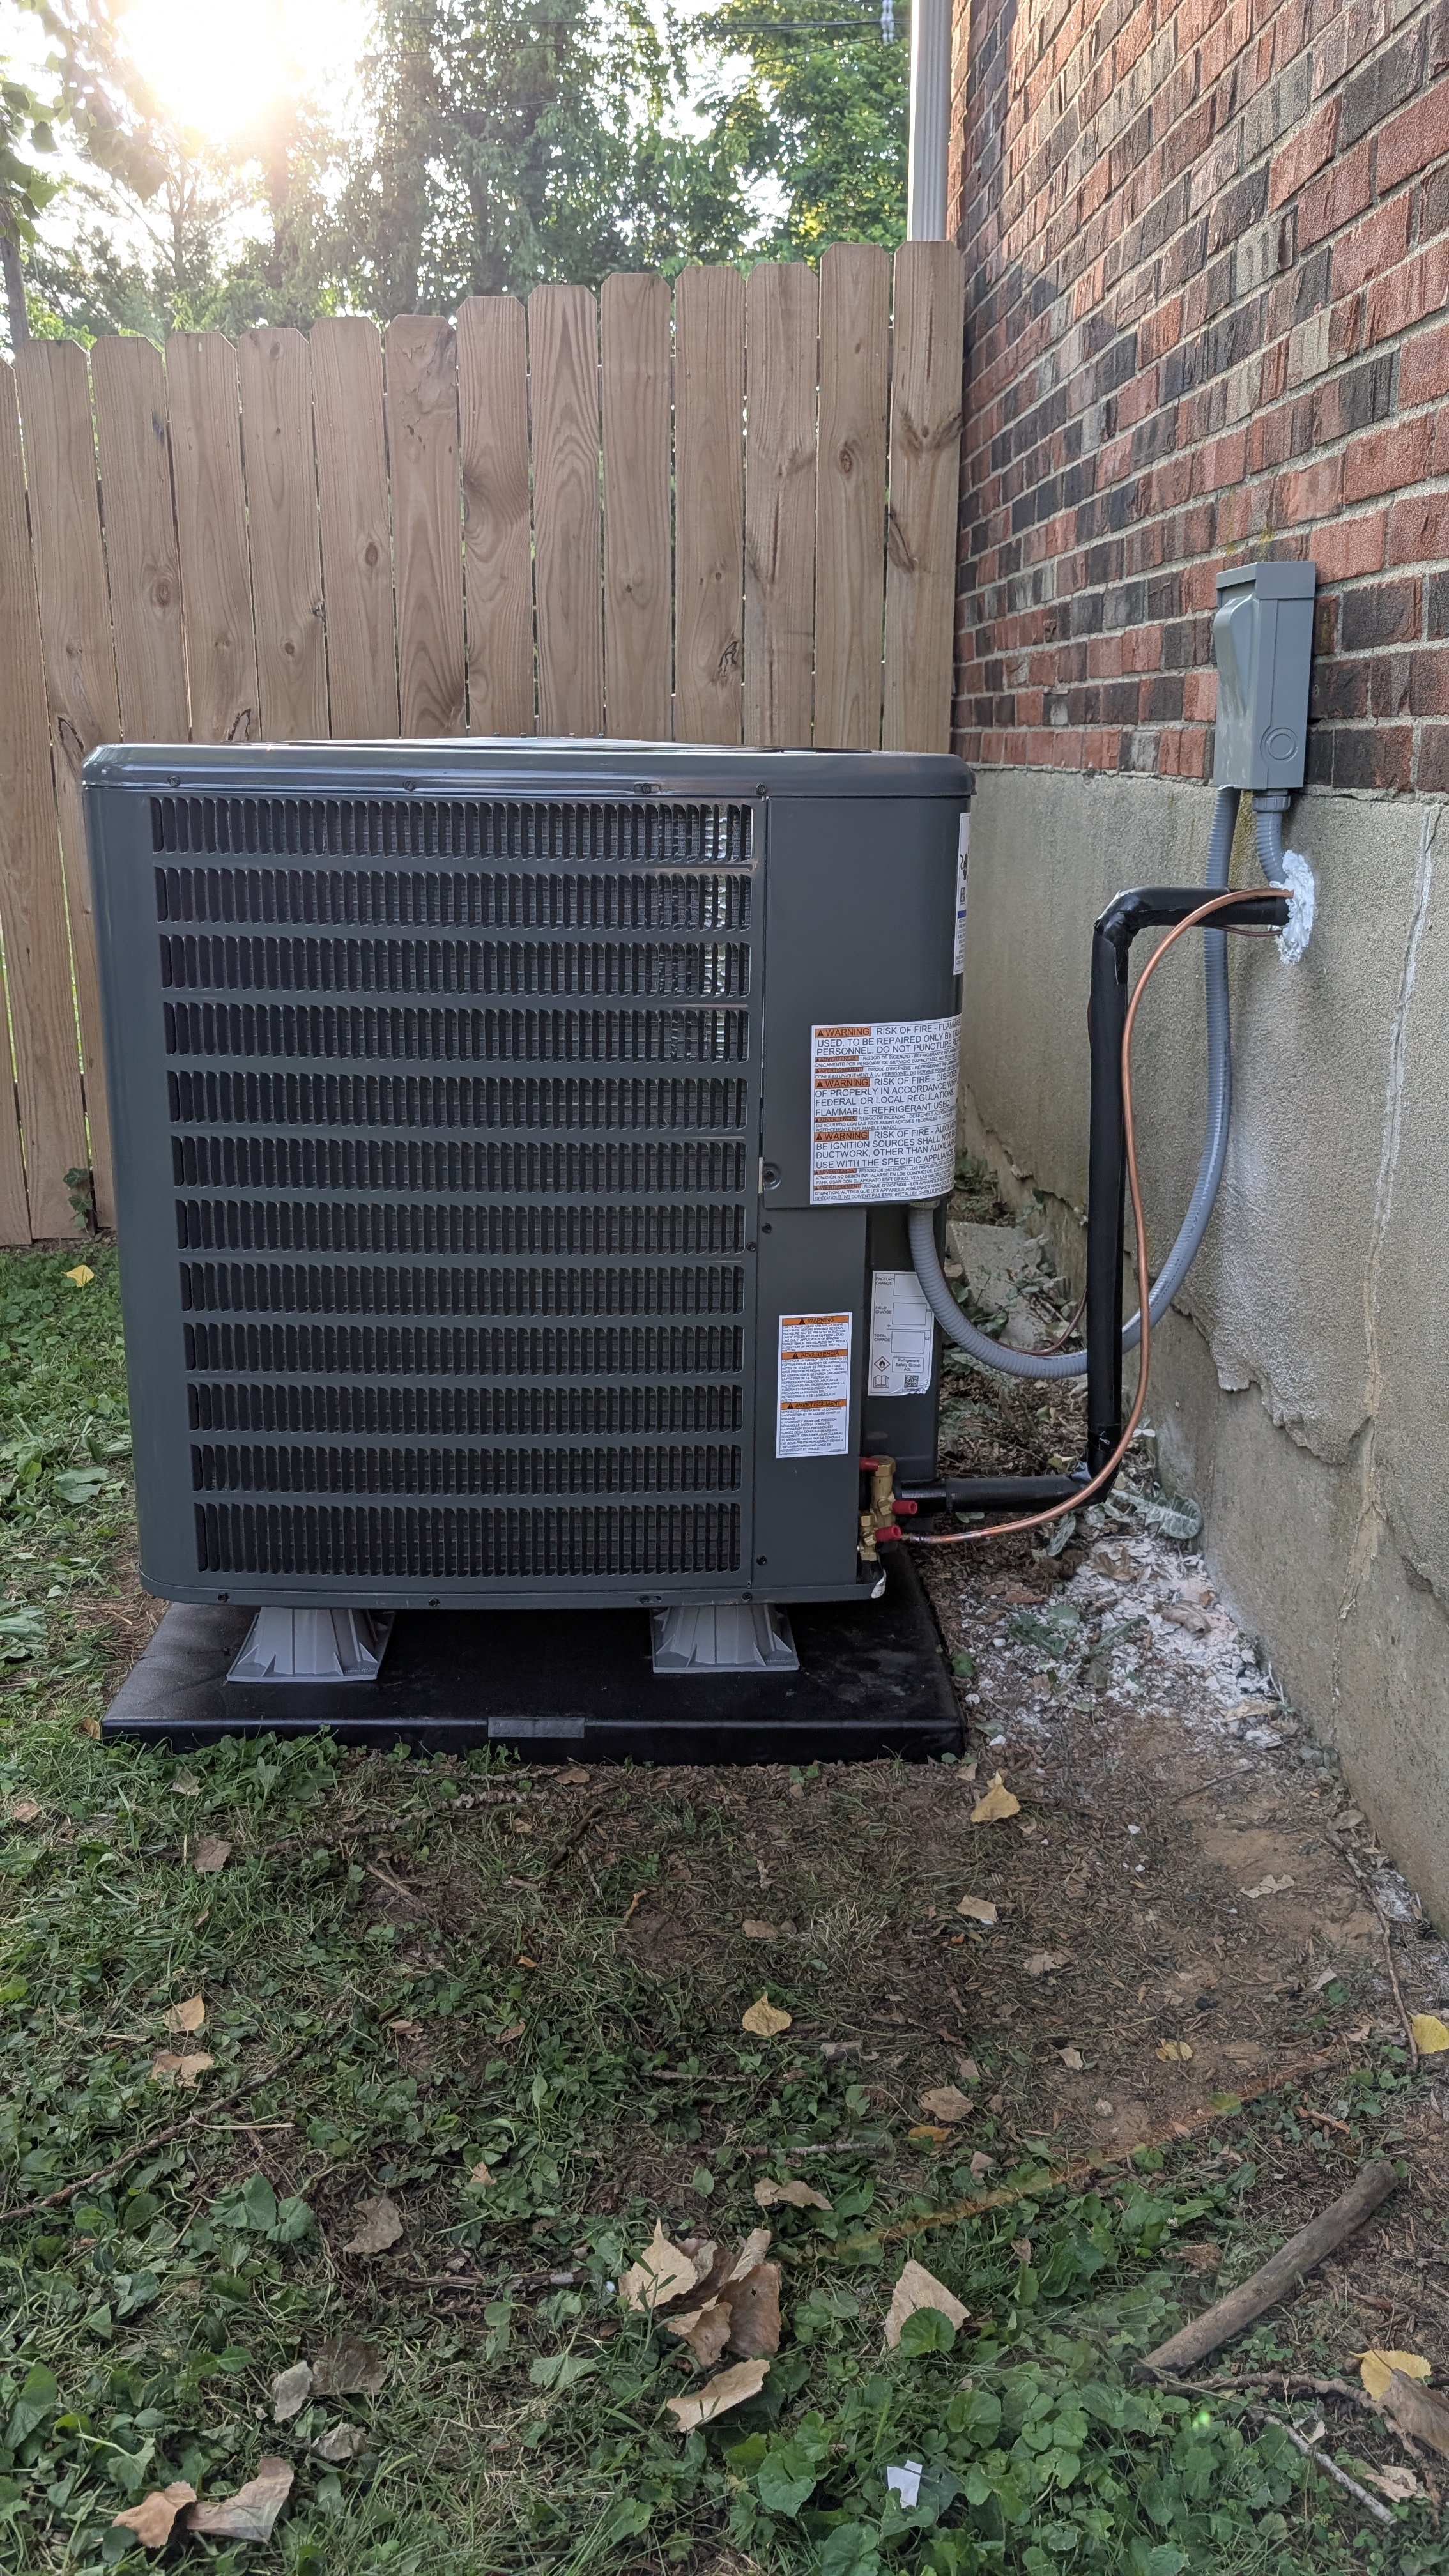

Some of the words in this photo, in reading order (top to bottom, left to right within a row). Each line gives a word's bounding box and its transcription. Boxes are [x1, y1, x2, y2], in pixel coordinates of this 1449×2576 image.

[826, 1028, 869, 1036] WARNING
[877, 1027, 897, 1035] RISK
[914, 1025, 932, 1033] FIRE
[818, 1039, 844, 1047] USED.
[877, 1036, 921, 1045] REPAIRED
[924, 1033, 943, 1042] ONLY
[944, 1031, 952, 1039] BY
[817, 1046, 873, 1055] PERSONNEL.
[877, 1045, 890, 1054] DO
[914, 1040, 951, 1052] PUNCTURE
[825, 1078, 868, 1087] WARNING
[912, 1075, 930, 1084] FIRE
[937, 1070, 957, 1081] DISPOSE
[831, 1088, 878, 1096] PROPERLY
[891, 1082, 946, 1094] ACCORDANCE
[816, 1098, 856, 1107] FEDERAL
[876, 1095, 904, 1104] LOCAL
[816, 1107, 869, 1116] FLAMMABLE
[872, 1103, 932, 1114] REFRIGERANT
[934, 1100, 951, 1109] USED.
[824, 1131, 868, 1140] WARNING
[912, 1128, 929, 1137] FIRE
[831, 1141, 870, 1149] IGNITION
[872, 1138, 915, 1147] SOURCES
[917, 1135, 940, 1145] SHALL
[942, 1131, 951, 1141] NOT
[816, 1149, 871, 1159] DUCTWORK,
[873, 1147, 904, 1156] OTHER
[906, 1146, 928, 1154] THAN
[836, 1160, 859, 1168] WITH
[882, 1156, 921, 1165] SPECIFIC
